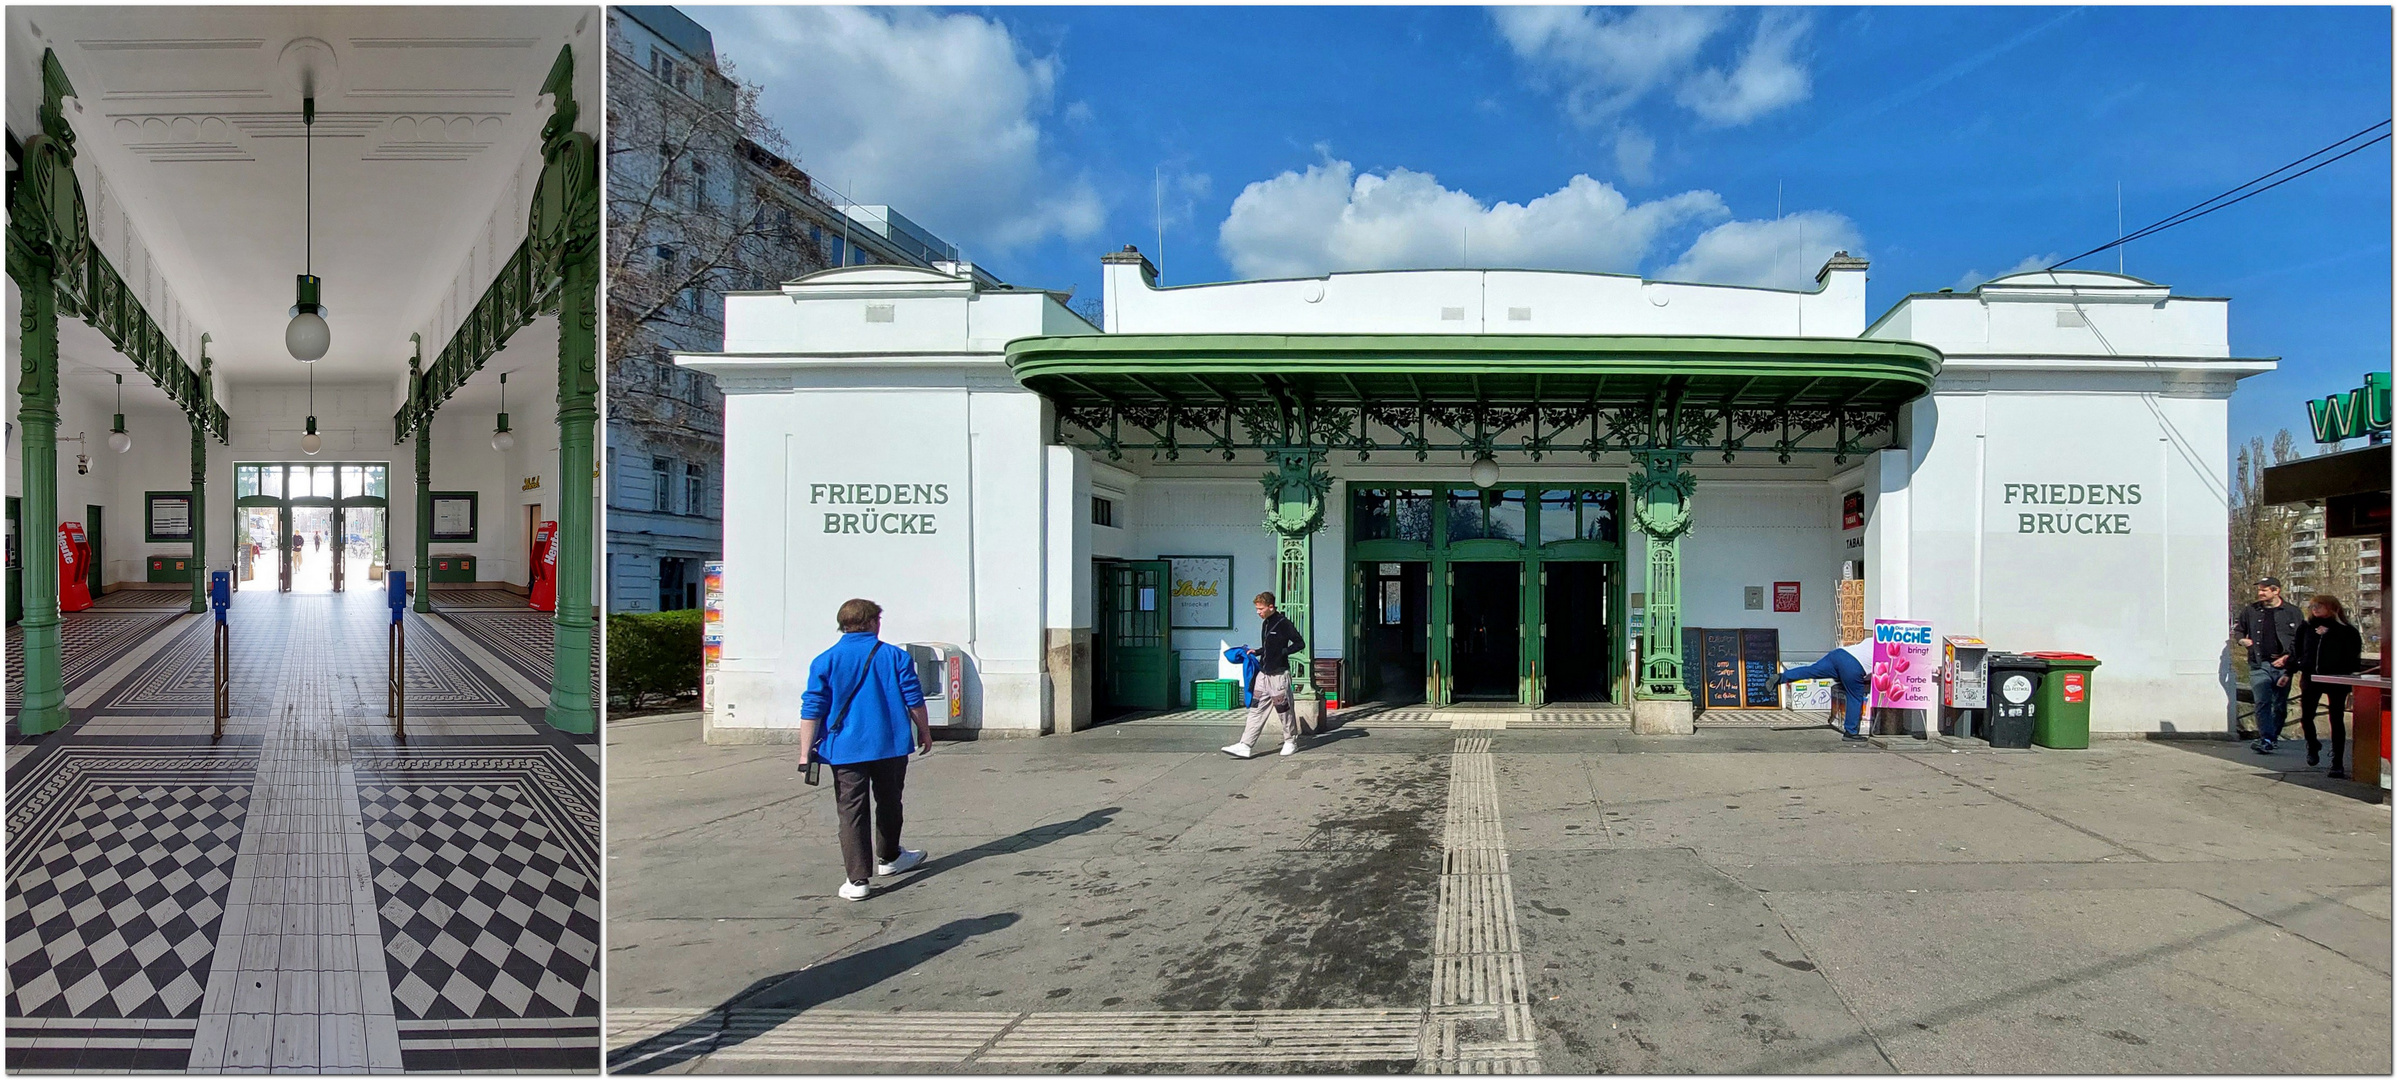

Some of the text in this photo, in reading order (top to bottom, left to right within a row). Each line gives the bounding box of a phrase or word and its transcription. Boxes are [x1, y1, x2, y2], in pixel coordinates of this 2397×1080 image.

[810, 483, 949, 504] FRIEDENS
[2004, 483, 2142, 504] FRIEDENS
[823, 508, 938, 534] BRÜCKE
[1877, 625, 1932, 644] WOCHE
[1908, 647, 1929, 656] bringt
[1906, 676, 1926, 684] Farbe
[1905, 693, 1930, 702] Leben.
